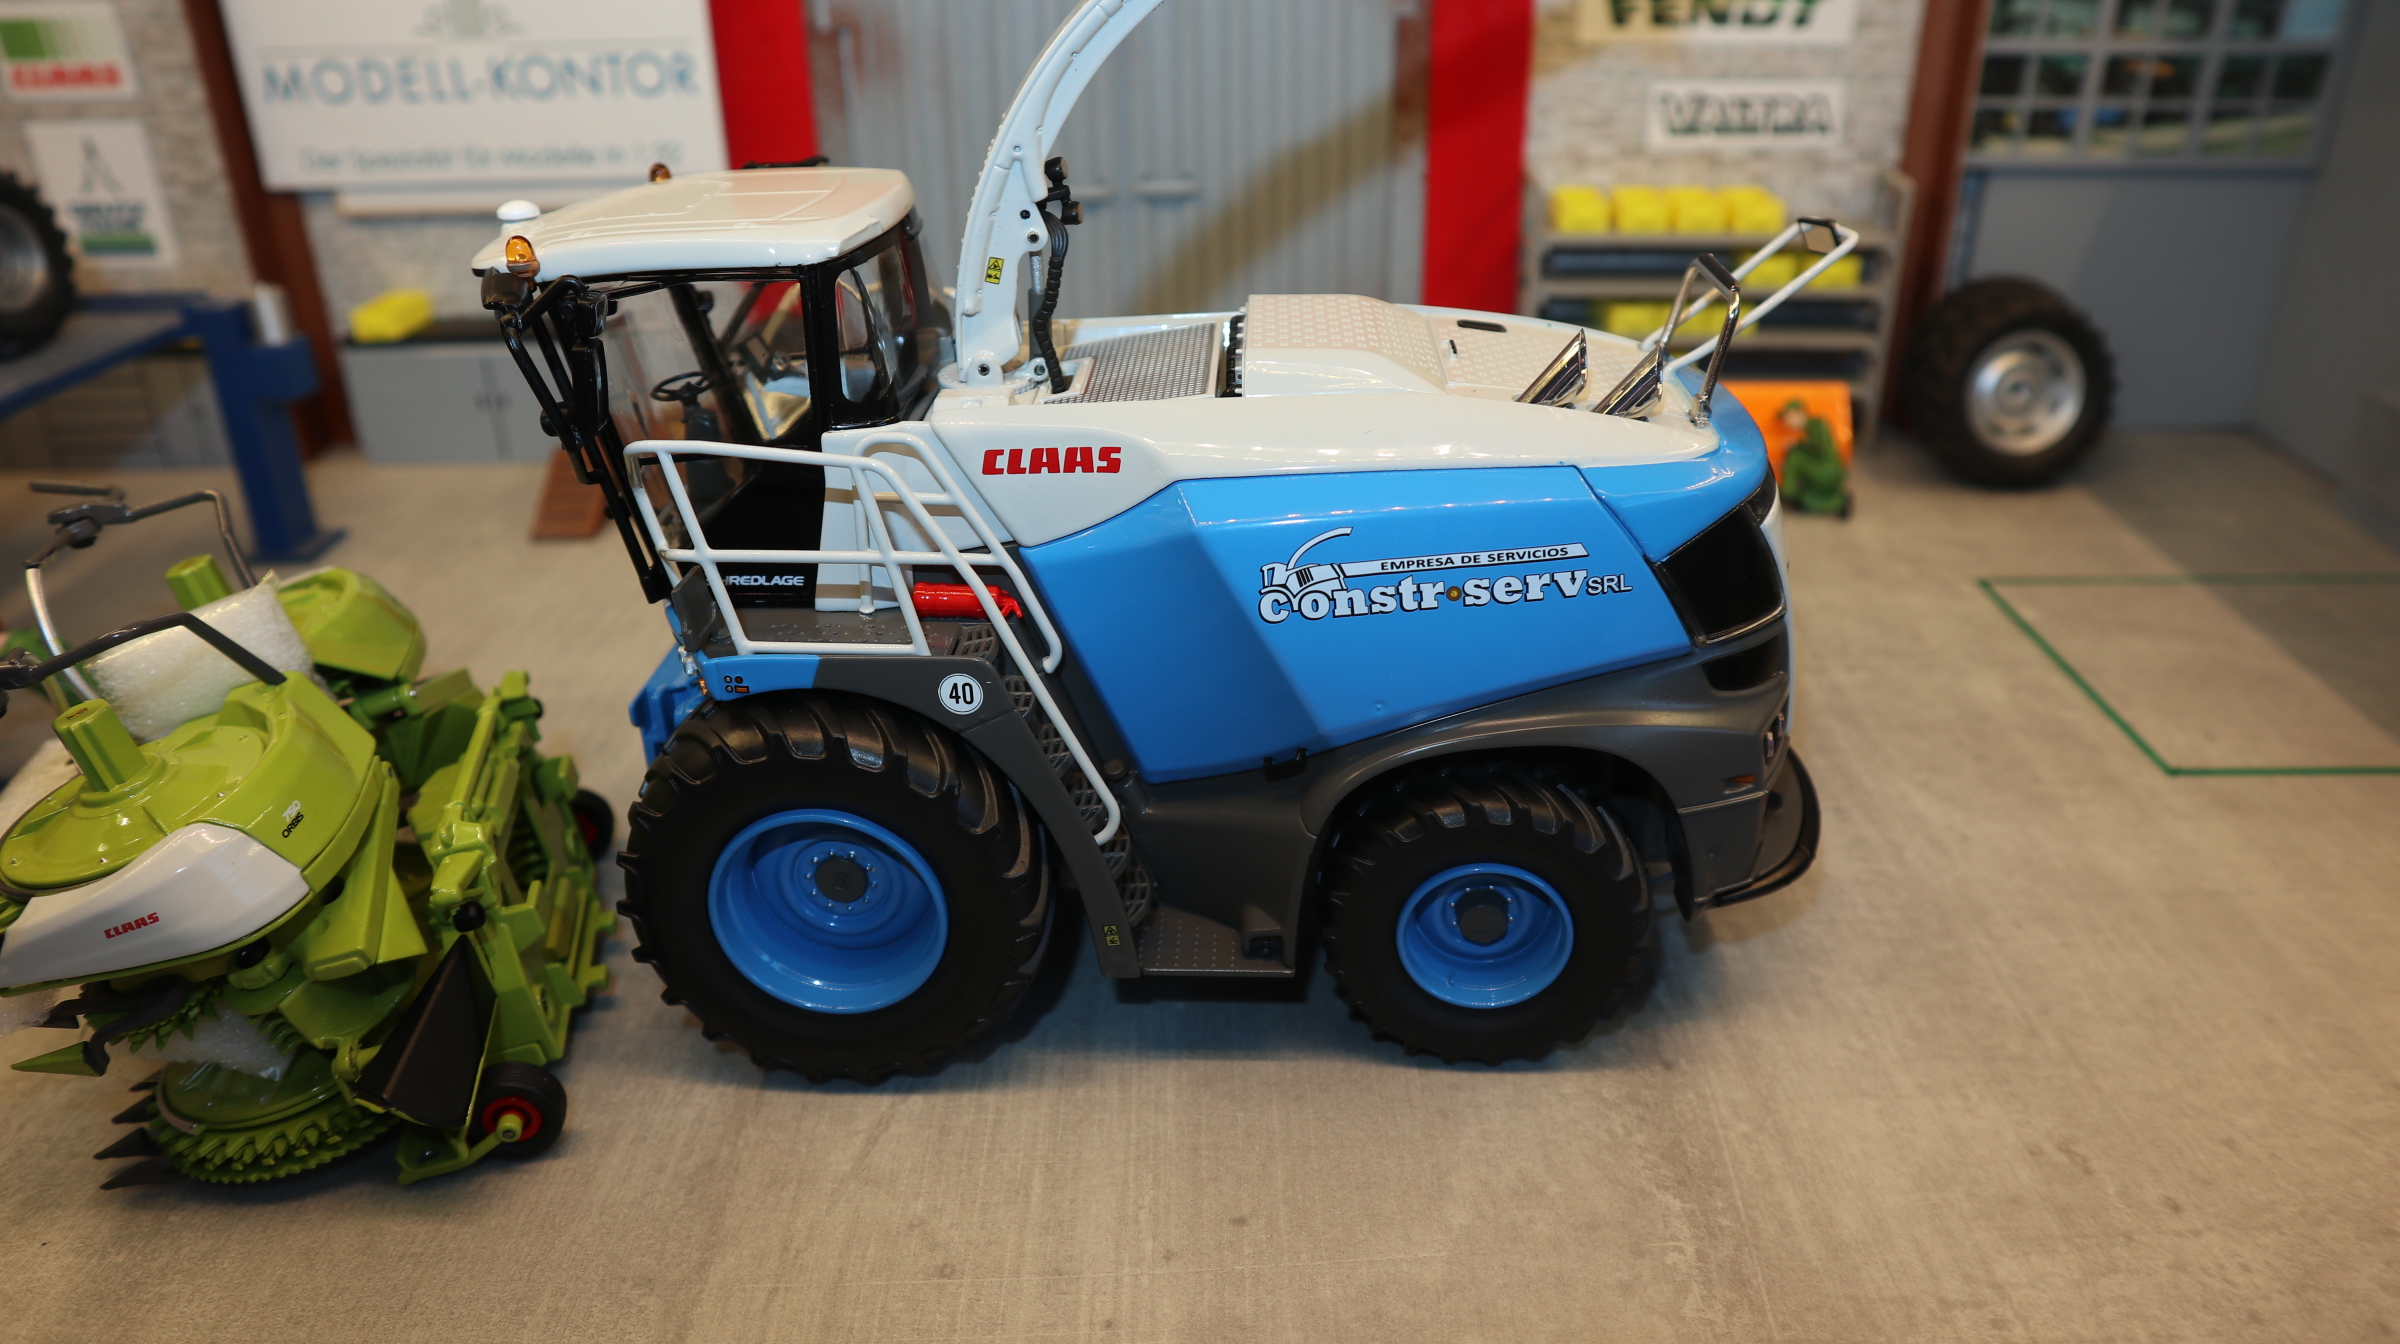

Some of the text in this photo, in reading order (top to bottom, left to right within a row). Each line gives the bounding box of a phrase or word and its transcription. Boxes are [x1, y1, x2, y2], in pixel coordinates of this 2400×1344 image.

[263, 51, 699, 104] MODELL-KONTOR
[982, 447, 1122, 475] CLAAS
[1380, 546, 1569, 572] EMPRESA DE SERVICIOS
[706, 575, 805, 586] HREDLAGE
[1586, 573, 1633, 597] SRL
[949, 682, 974, 705] 40
[282, 812, 304, 838] ORBIS
[104, 912, 160, 939] CLAAS
